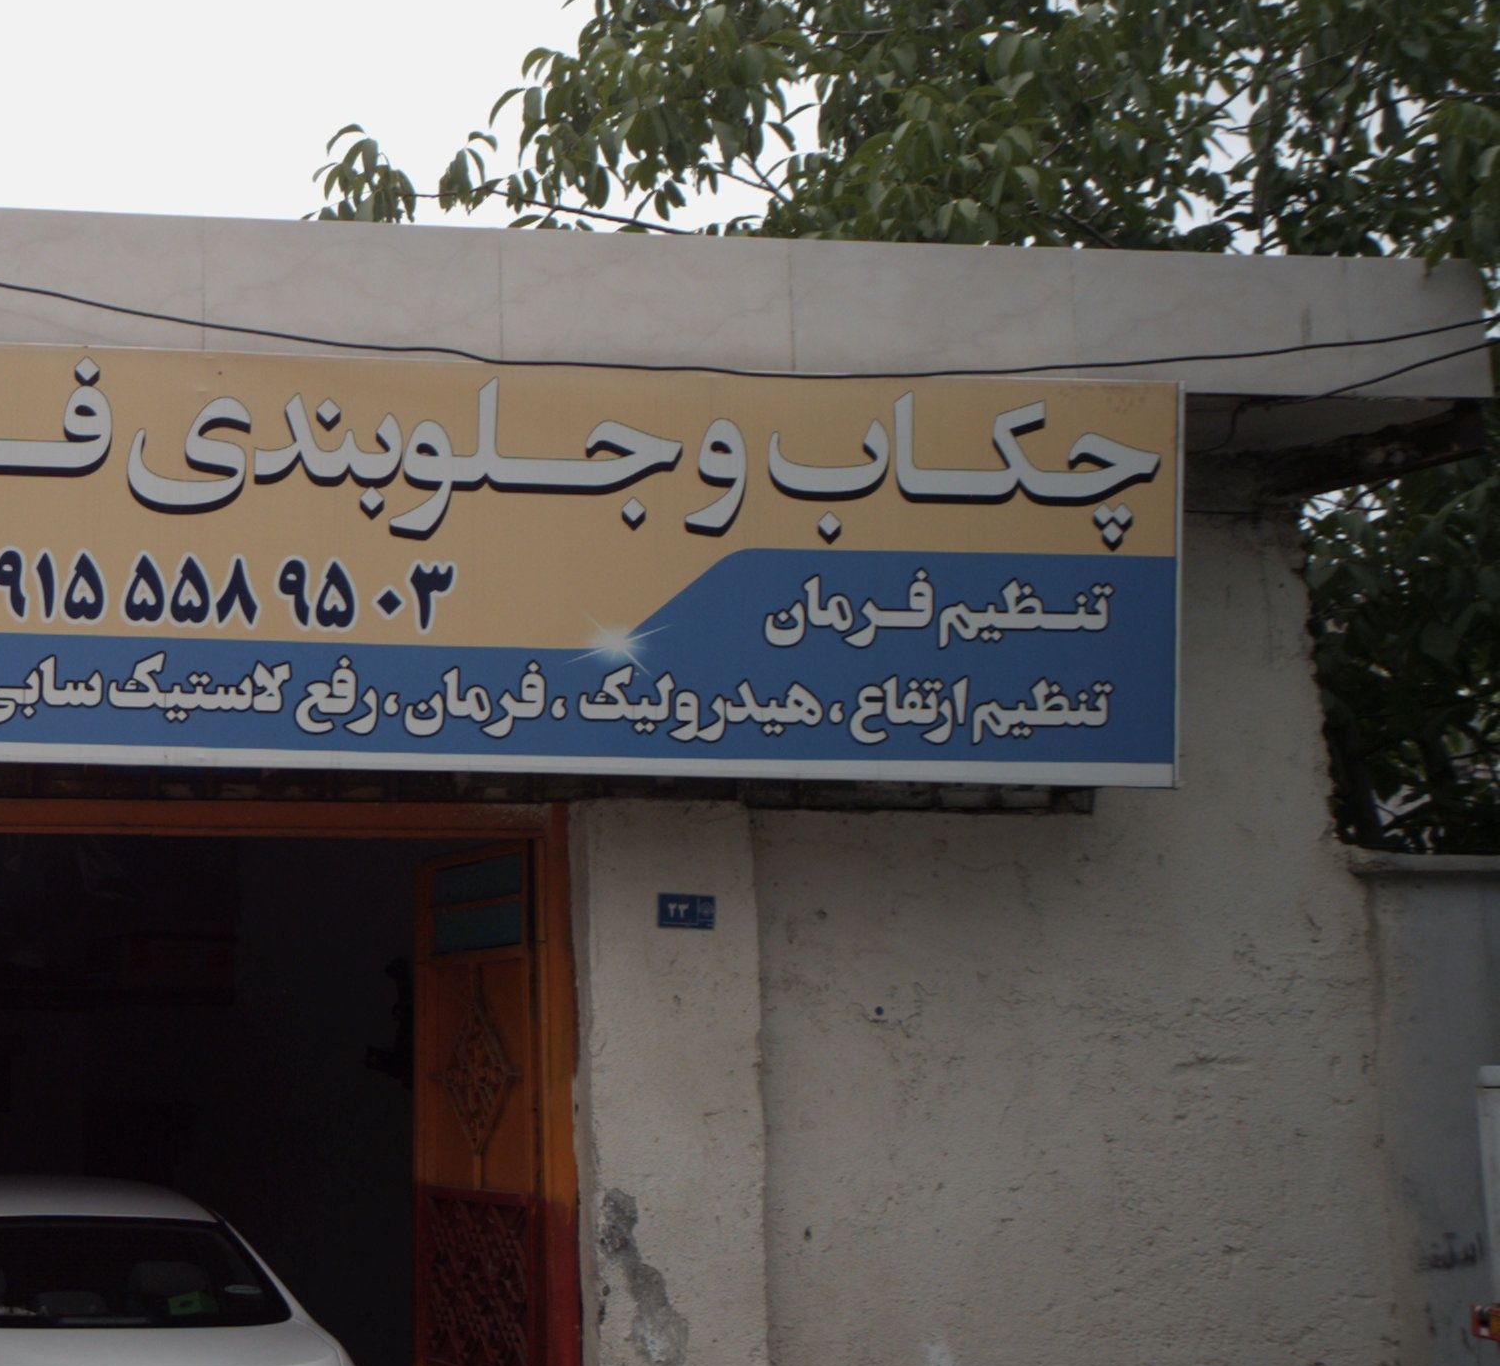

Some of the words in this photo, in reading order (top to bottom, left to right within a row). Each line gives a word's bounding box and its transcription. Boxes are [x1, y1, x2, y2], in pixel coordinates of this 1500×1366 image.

[127, 376, 683, 539] جلوبندی
[685, 418, 747, 535] و
[768, 390, 1160, 550] چکاب
[122, 553, 260, 626] ۵۵۸
[279, 557, 357, 629] ۹۵
[375, 561, 455, 632] ۰۳
[764, 568, 934, 647] فرمان
[939, 578, 1114, 648] تنظیم
[108, 652, 290, 722] لاستیک
[294, 656, 379, 735] رفع
[971, 677, 1114, 744] تنظیم
